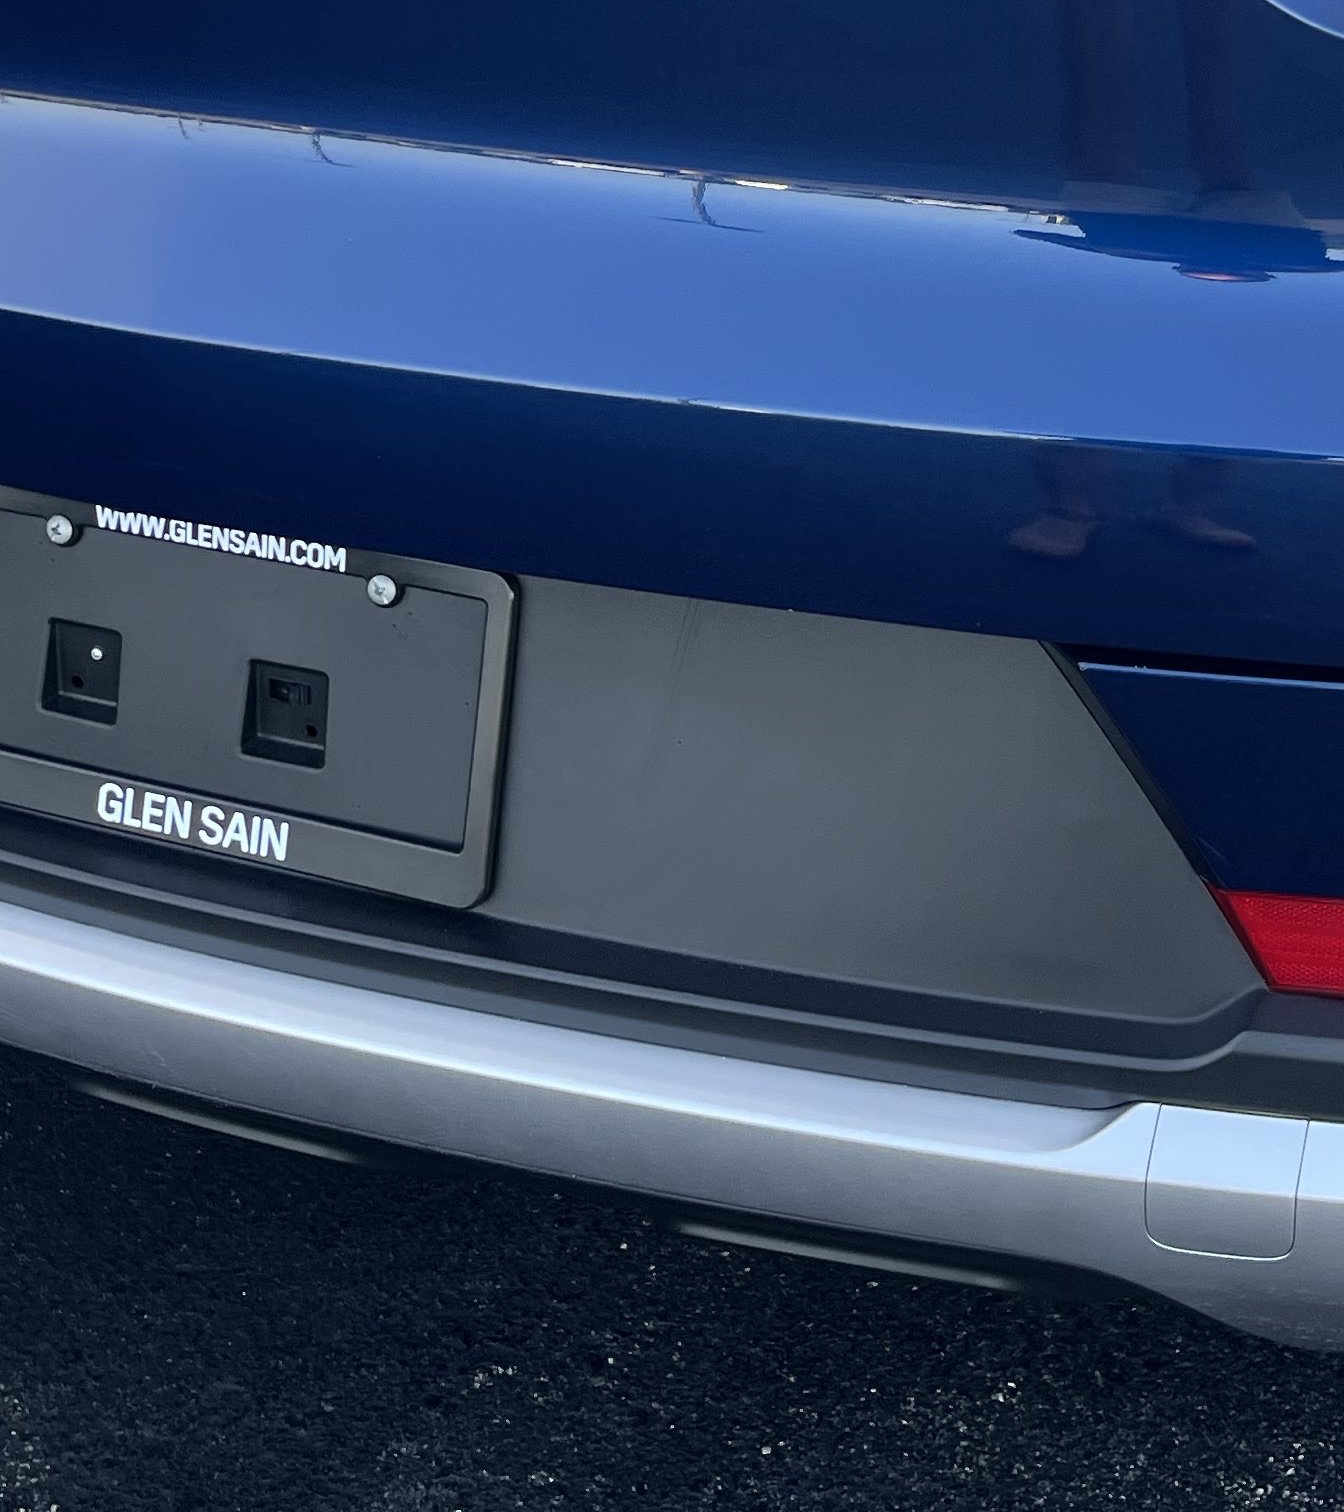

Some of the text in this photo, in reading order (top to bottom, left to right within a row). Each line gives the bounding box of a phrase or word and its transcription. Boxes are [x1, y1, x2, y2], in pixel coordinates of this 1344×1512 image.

[94, 504, 347, 573] WWW.GLENSAIN.COM
[96, 782, 291, 862] GLEN SAIN
